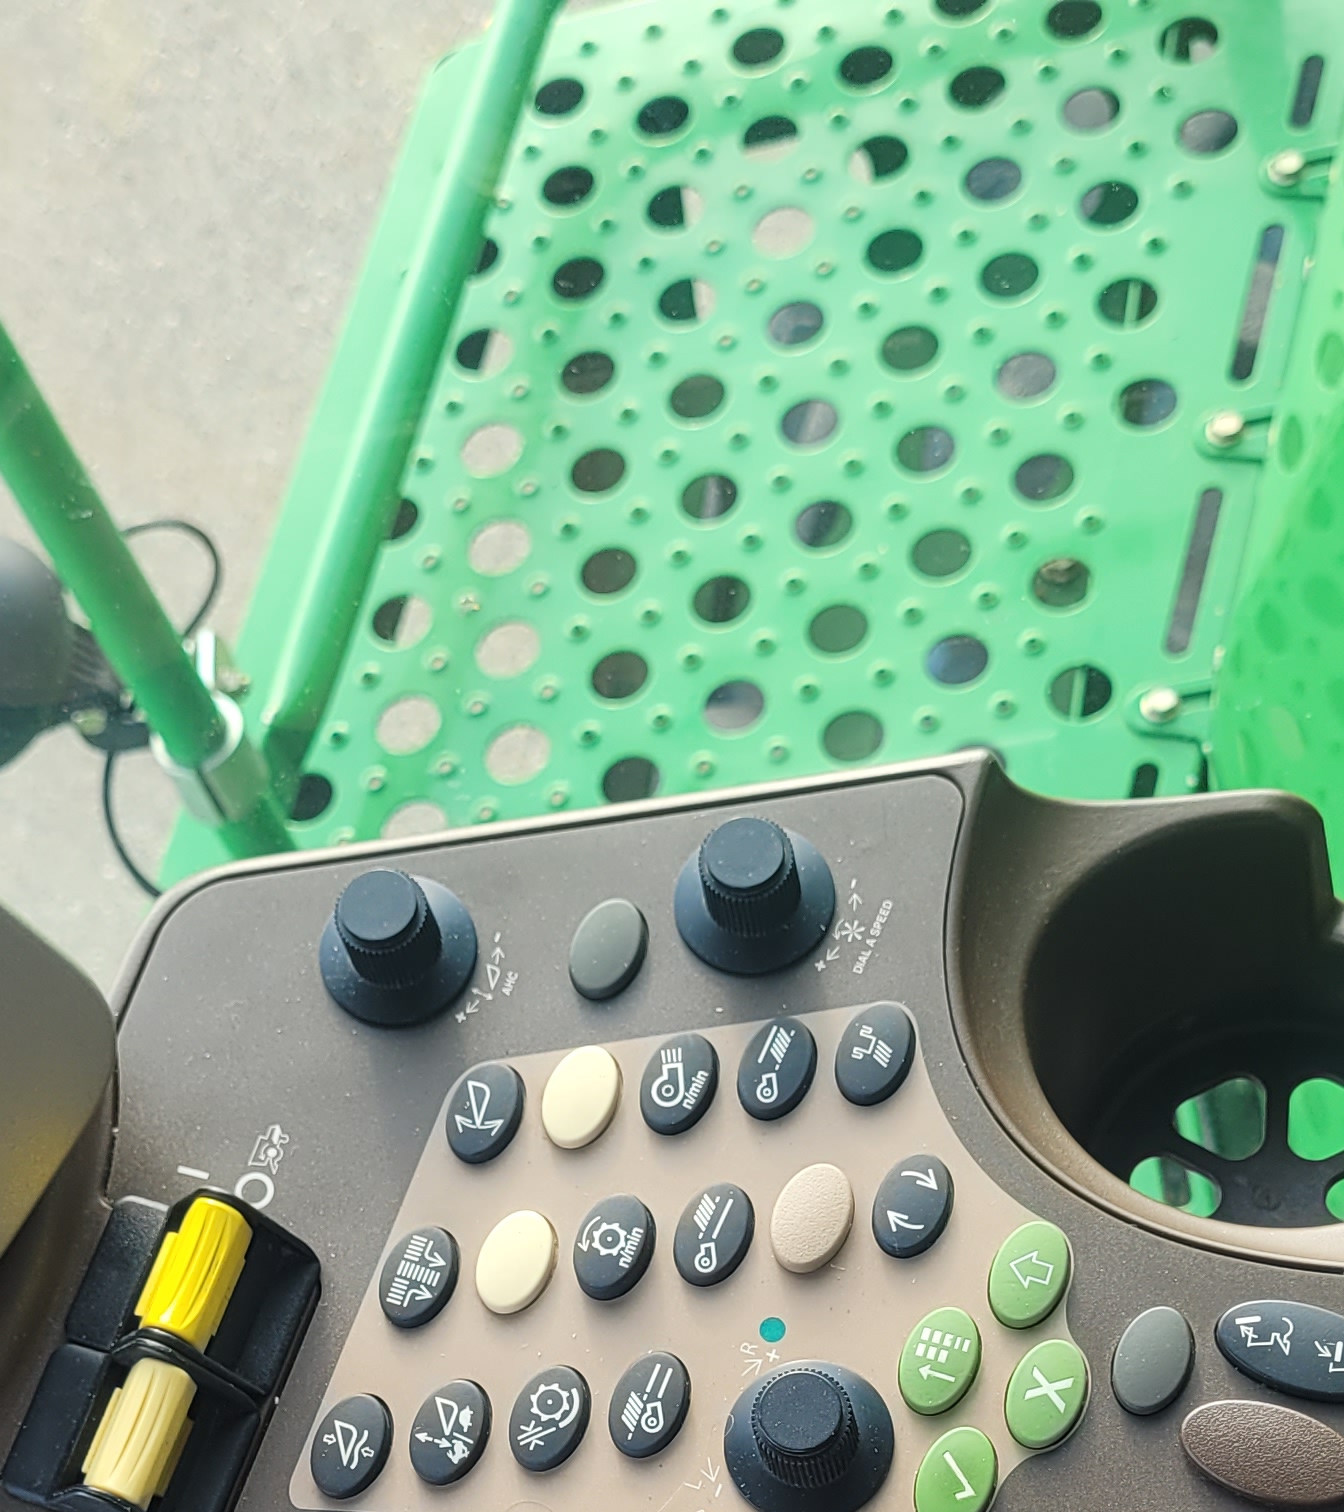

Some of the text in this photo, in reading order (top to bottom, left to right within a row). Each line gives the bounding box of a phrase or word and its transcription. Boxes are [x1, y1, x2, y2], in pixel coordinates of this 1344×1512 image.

[852, 899, 894, 975] DIAL A SPEED
[501, 970, 519, 997] AHC
[682, 1070, 709, 1110] n/min
[618, 1227, 644, 1268] n/min
[739, 1342, 759, 1356] R
